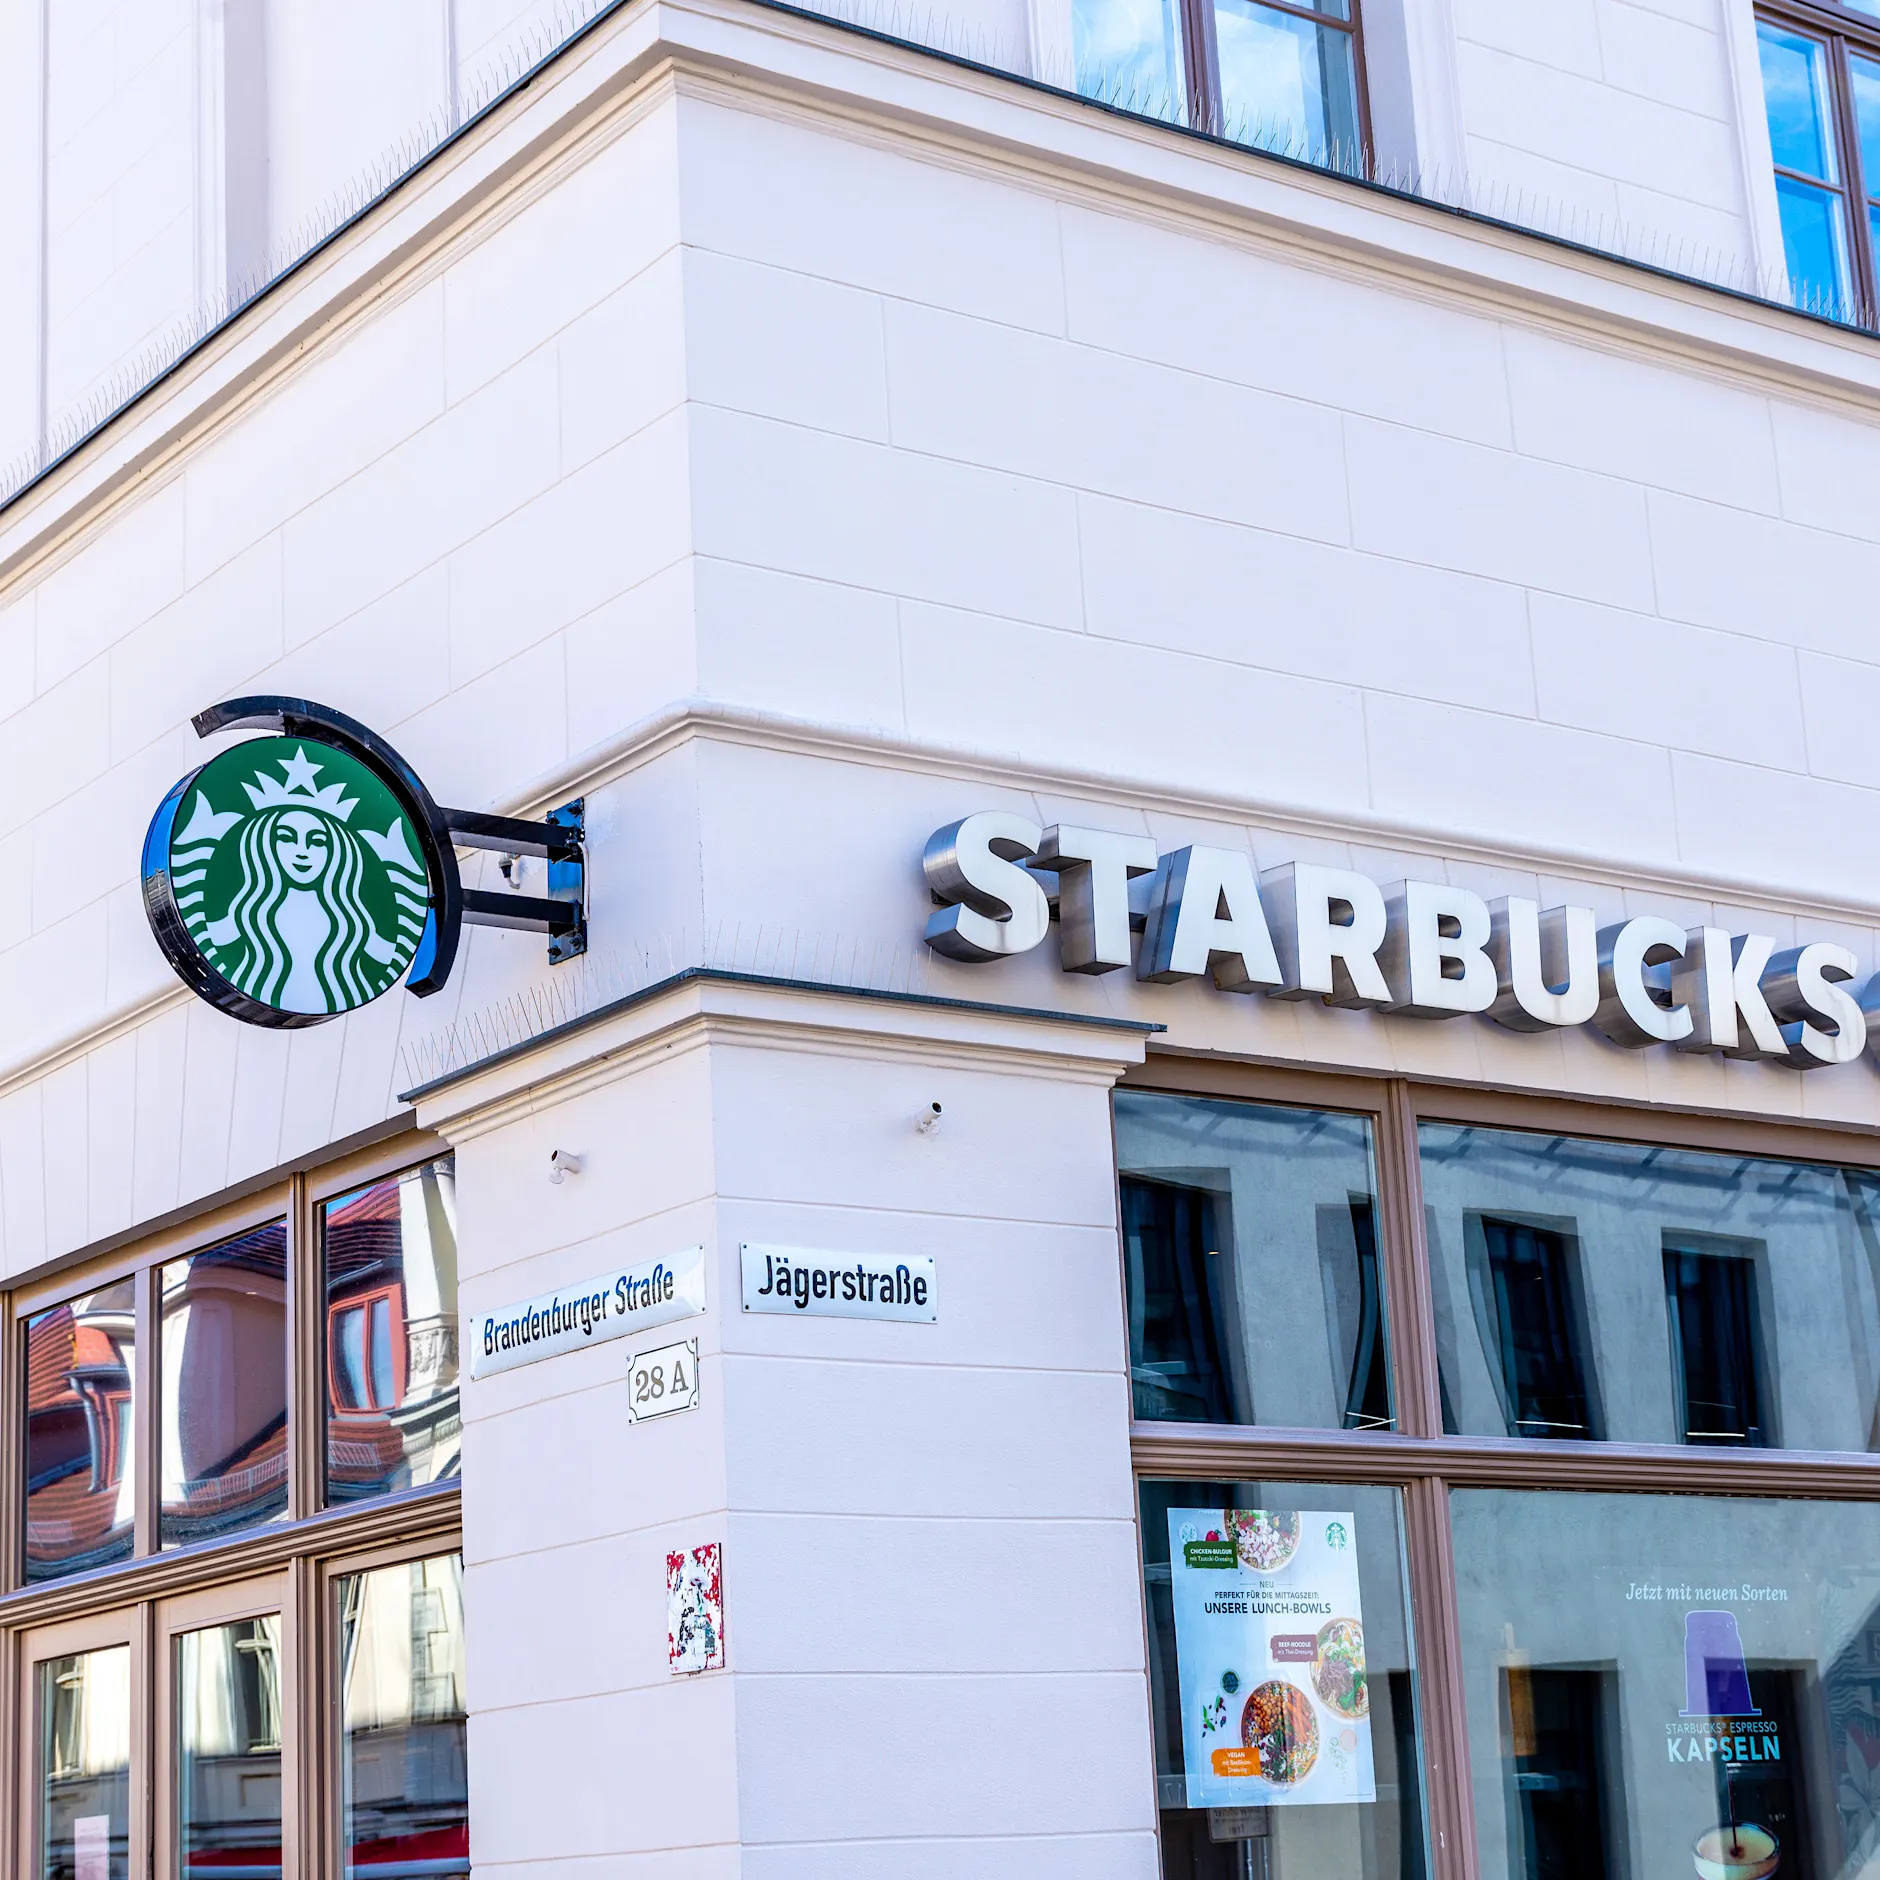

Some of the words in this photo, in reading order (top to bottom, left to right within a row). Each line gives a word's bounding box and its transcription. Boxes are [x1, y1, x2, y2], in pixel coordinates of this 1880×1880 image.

[923, 810, 1868, 1071] STARBUCKS
[758, 1255, 928, 1309] Jägerstraße
[484, 1290, 610, 1356] Brandenburger
[615, 1263, 674, 1315] Straße
[636, 1366, 665, 1403] 28
[670, 1360, 689, 1395] A
[1214, 1591, 1245, 1599] PERFEKT
[1246, 1589, 1260, 1599] FÜR
[1261, 1591, 1273, 1599] DIE
[1274, 1591, 1320, 1599] MITTAGSZEIT:
[1626, 1583, 1662, 1600] Jetzt
[1665, 1583, 1692, 1600] mit
[1695, 1586, 1738, 1600] neuen
[1741, 1584, 1788, 1601] Sorten
[1204, 1602, 1248, 1614] UNSERE
[1252, 1602, 1331, 1614] LUNCH-BOWLS
[1730, 1722, 1778, 1733] ESPRESSO
[1667, 1736, 1780, 1762] KAPSELN
